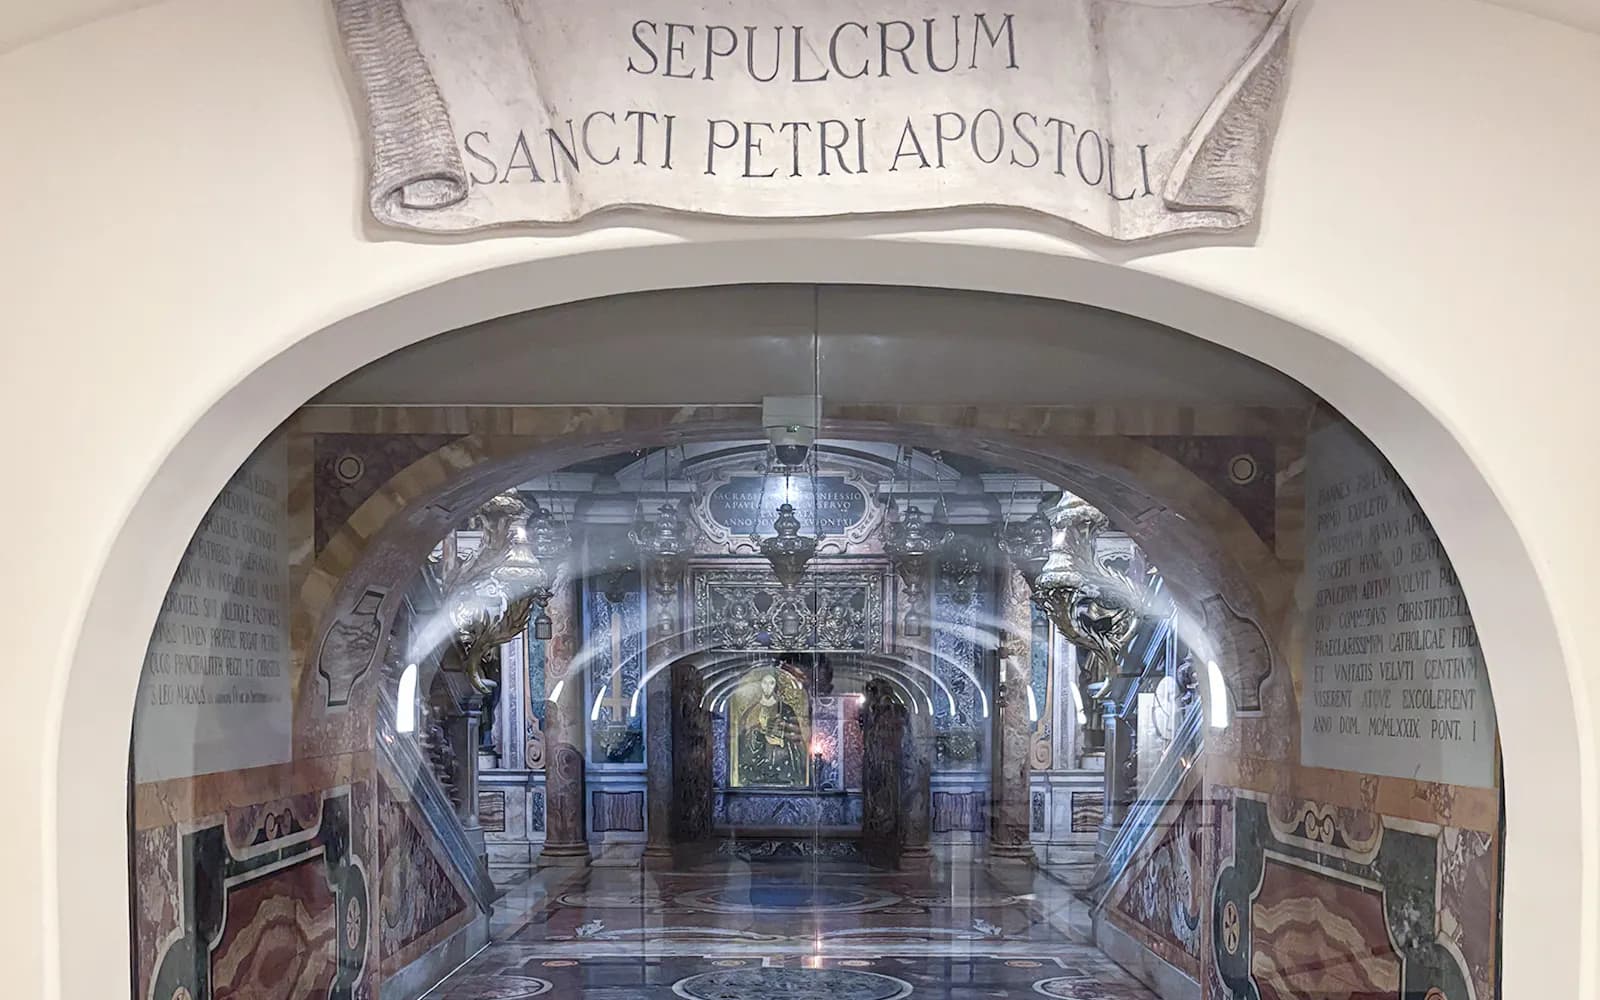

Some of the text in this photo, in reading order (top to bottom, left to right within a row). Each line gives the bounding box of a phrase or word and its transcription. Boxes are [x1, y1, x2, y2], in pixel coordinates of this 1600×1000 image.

[627, 14, 1019, 83] SEPULCRUM
[464, 109, 1155, 201] SANCTI PETRI APOSTOLI
[1389, 627, 1446, 653] CATHOLICAE
[1402, 687, 1476, 710] EXCOLERENT
